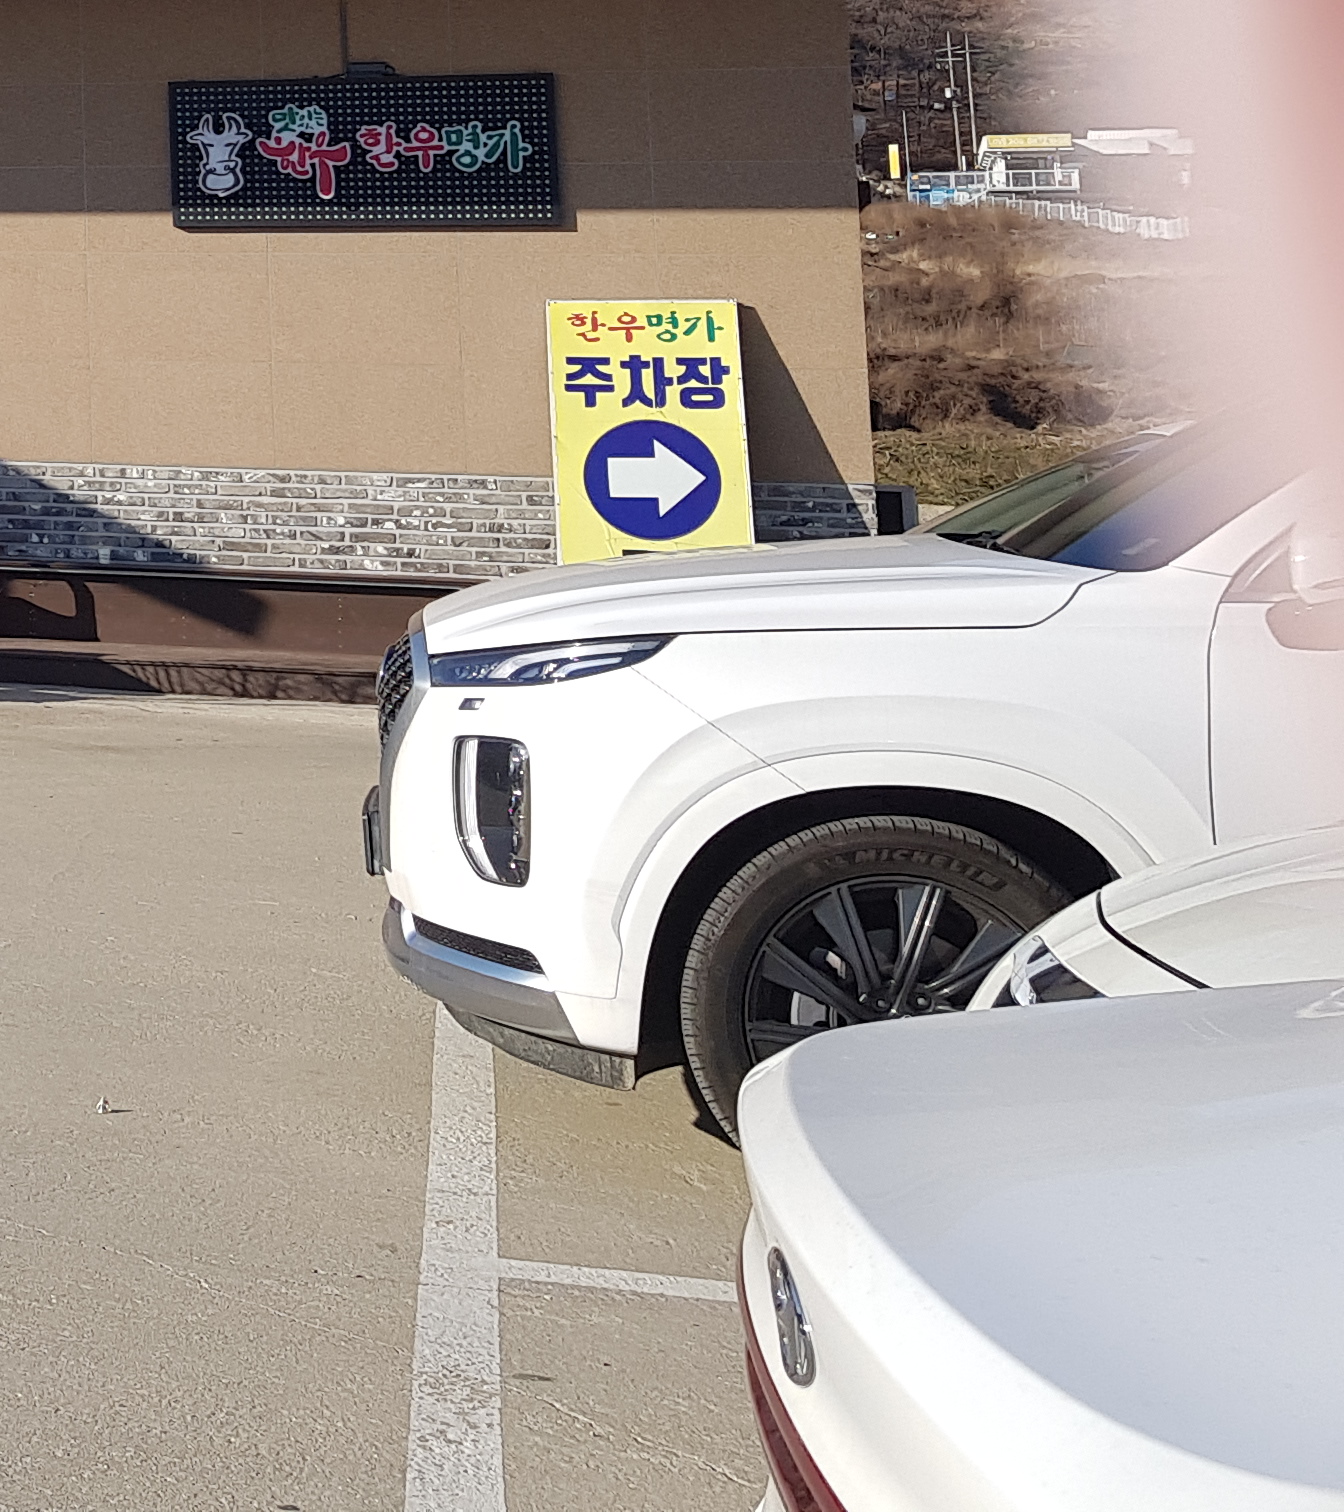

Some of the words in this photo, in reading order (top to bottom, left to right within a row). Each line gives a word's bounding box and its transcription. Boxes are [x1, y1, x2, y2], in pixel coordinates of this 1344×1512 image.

[270, 105, 325, 134] 맛있는
[257, 130, 348, 197] 한우
[357, 121, 531, 172] 한우명가
[566, 309, 725, 343] 한우명가
[564, 354, 731, 409] 주차장
[854, 847, 1008, 891] MICHELIN
